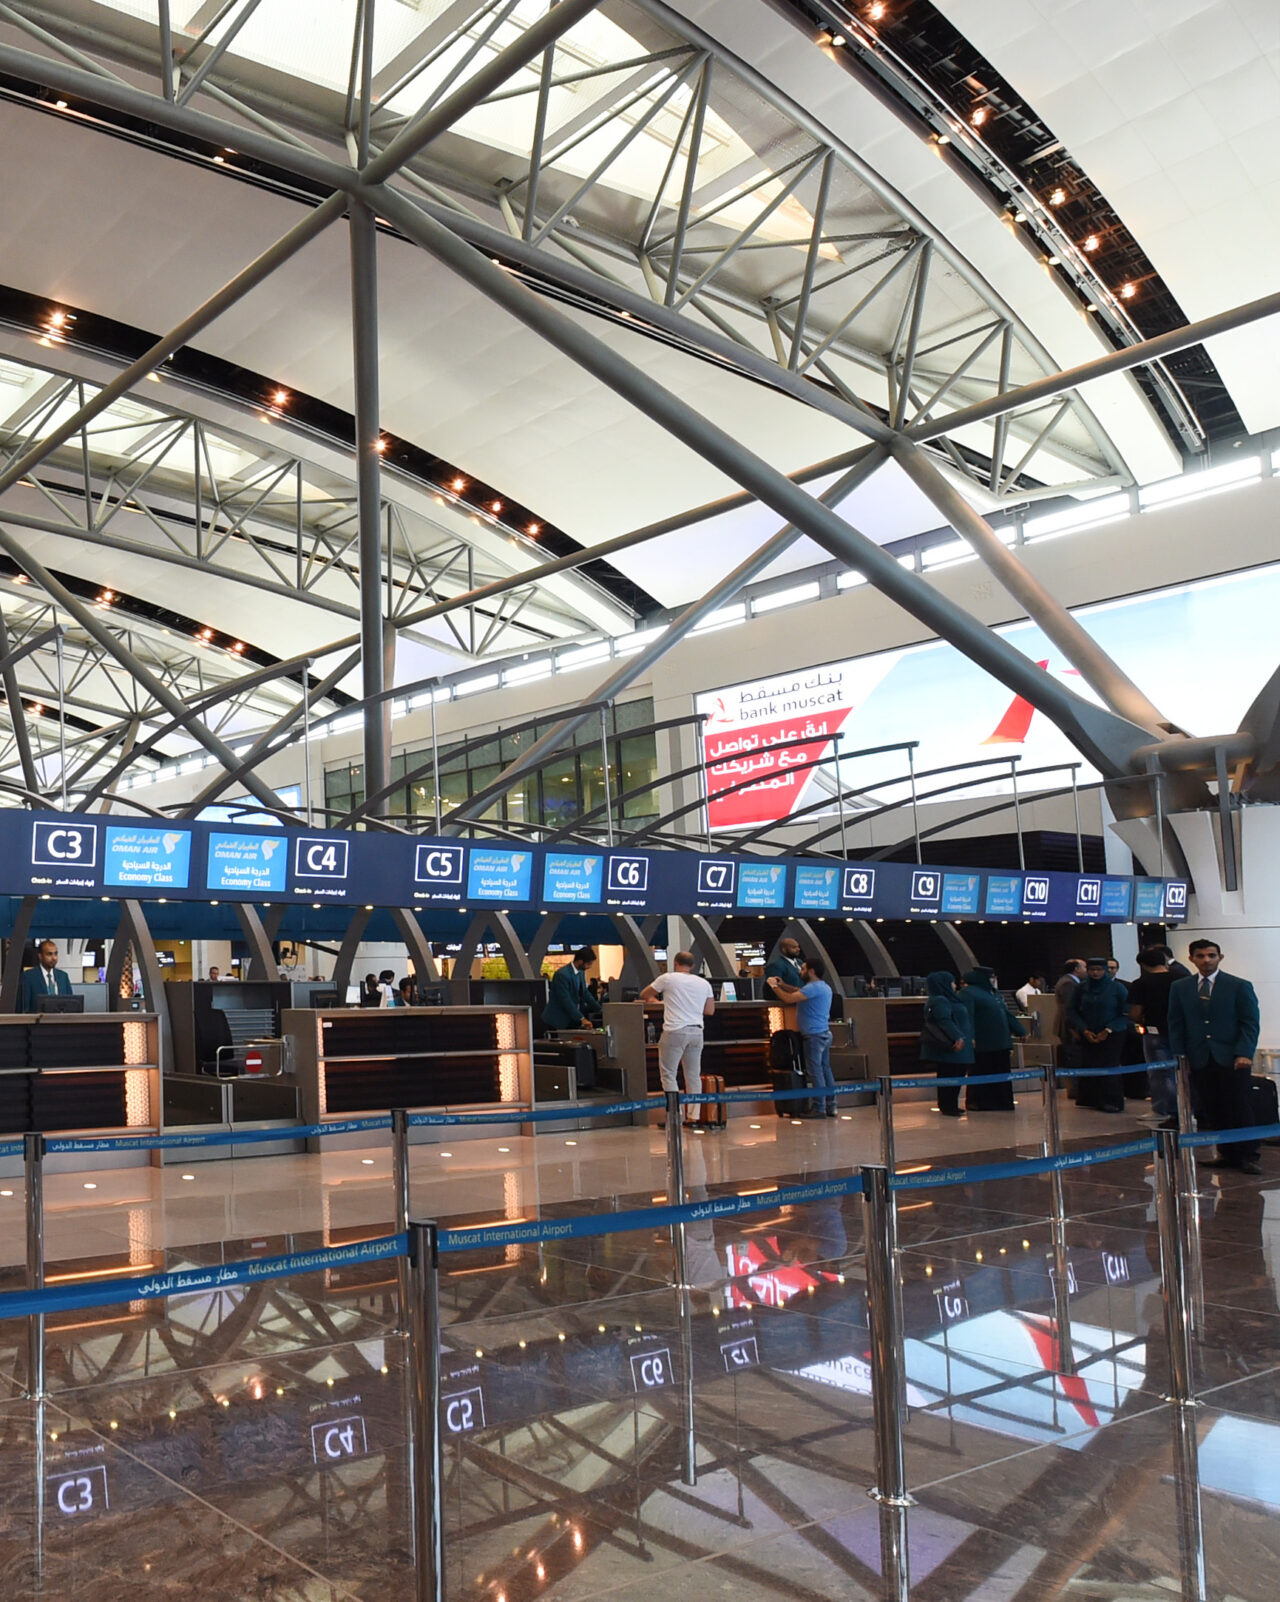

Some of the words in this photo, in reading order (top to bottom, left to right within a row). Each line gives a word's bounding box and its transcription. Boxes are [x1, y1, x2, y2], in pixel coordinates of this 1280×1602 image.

[805, 673, 842, 688] بنك
[739, 682, 800, 703] مسقط
[740, 702, 777, 720] bank
[783, 689, 843, 712] muscat
[710, 734, 758, 757] تواصل
[778, 751, 807, 766] مع
[47, 830, 82, 859] C3
[111, 845, 141, 853] OMAN
[142, 846, 158, 854] AIR
[307, 845, 337, 871] C4
[426, 851, 453, 877] C5
[118, 872, 152, 884] Economy
[153, 873, 173, 882] Class
[221, 877, 252, 888] Economy
[253, 878, 271, 887] Class
[617, 862, 640, 885] C6
[706, 866, 727, 887] C7
[850, 873, 868, 893] C8
[478, 888, 503, 898] Economy
[504, 889, 518, 897] Class
[918, 876, 934, 895] C9
[1027, 882, 1046, 899] C10
[1080, 884, 1097, 901] C11
[1168, 887, 1184, 903] C12
[756, 1194, 781, 1205] Muscat
[782, 1186, 824, 1201] International
[824, 1182, 848, 1194] Airport
[448, 1232, 481, 1245] Muscat
[483, 1226, 540, 1242] International
[542, 1223, 573, 1237] Airport
[248, 1260, 287, 1276] Muscat
[290, 1249, 359, 1269] International
[360, 1239, 398, 1257] Airport
[138, 1276, 174, 1295] الدولي
[177, 1272, 212, 1287] مسقط
[216, 1267, 238, 1285] مطار
